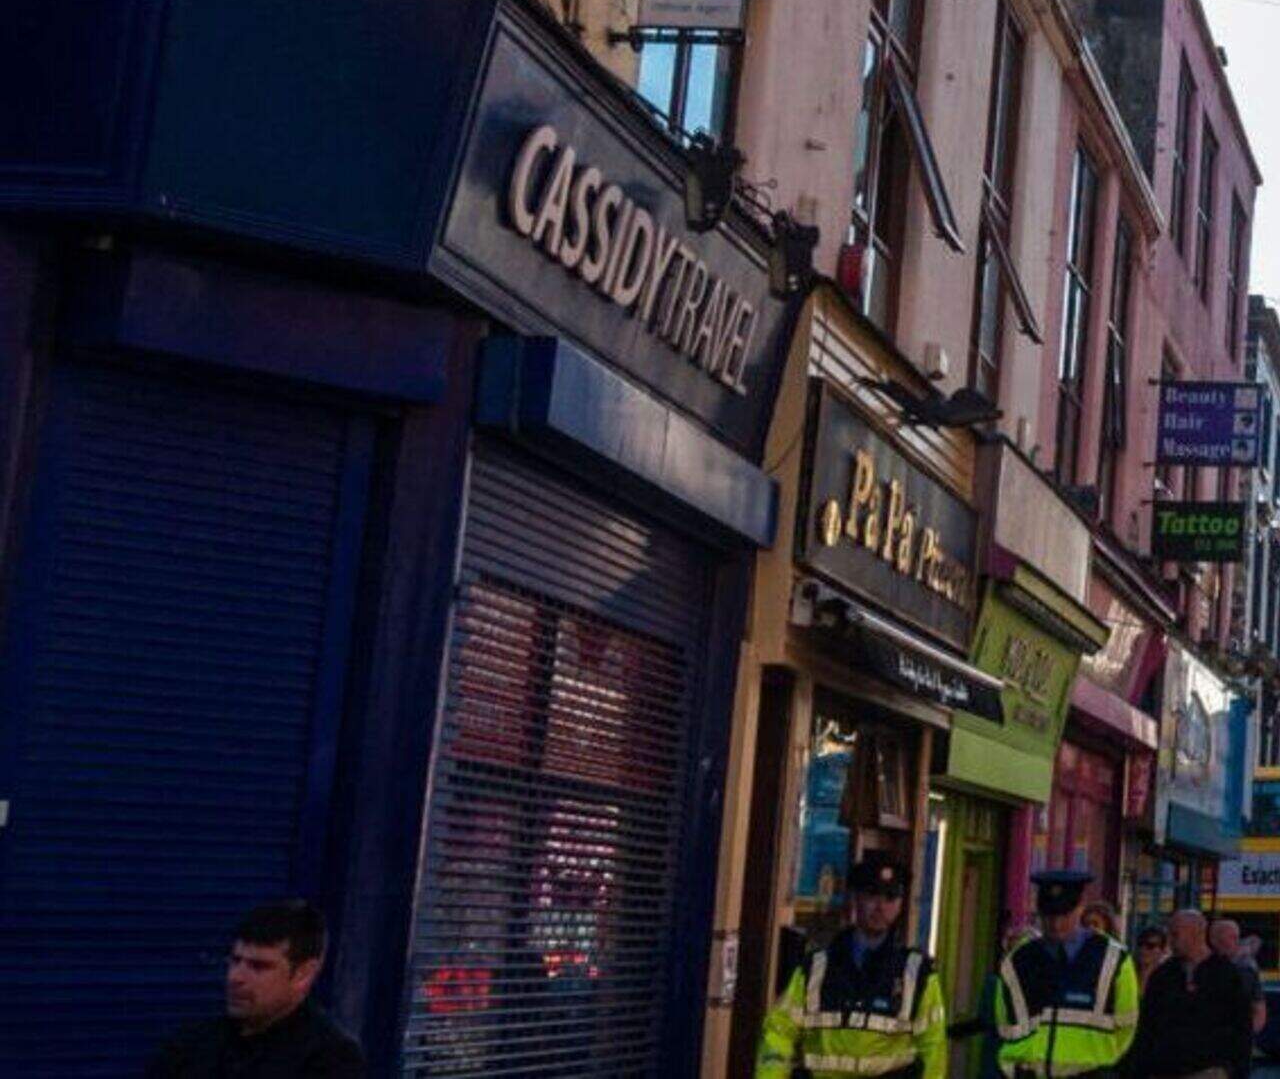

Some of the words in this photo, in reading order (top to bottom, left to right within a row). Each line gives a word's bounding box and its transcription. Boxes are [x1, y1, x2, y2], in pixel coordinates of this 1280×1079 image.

[509, 125, 678, 322] CASSIDY
[660, 242, 760, 397] TRAVEL
[1165, 387, 1227, 405] Beauty
[1163, 412, 1204, 430] Hair
[1163, 437, 1231, 458] Massage
[1158, 510, 1240, 534] Tattoo
